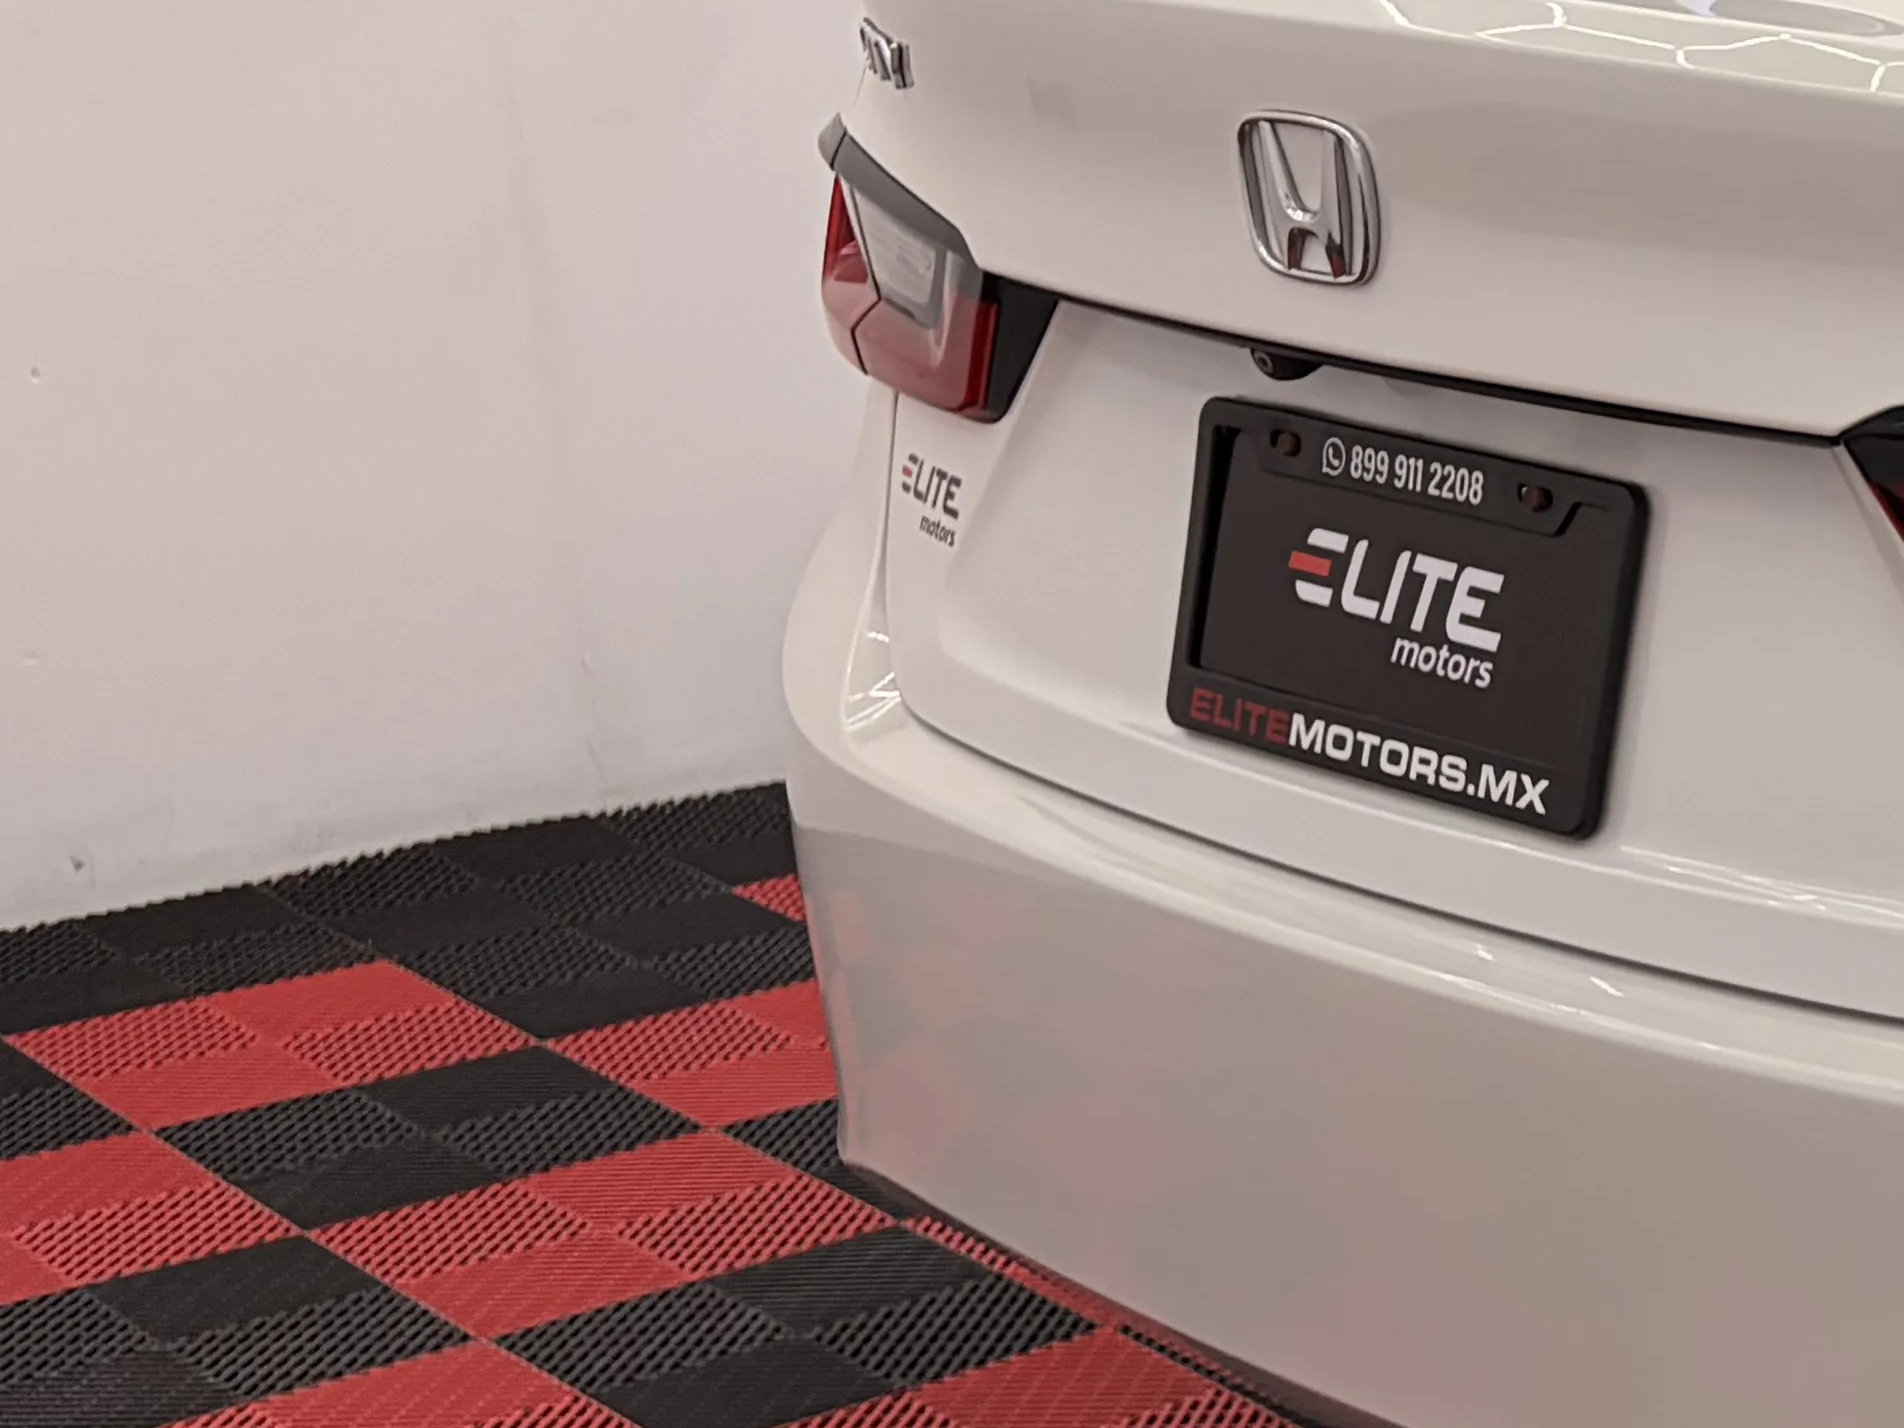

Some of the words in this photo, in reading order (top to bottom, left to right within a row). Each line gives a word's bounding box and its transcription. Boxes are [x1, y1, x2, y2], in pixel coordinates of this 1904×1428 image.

[902, 452, 962, 521] ELITE
[1350, 445, 1389, 484] 899
[1394, 454, 1423, 492] 911
[1427, 462, 1484, 505] 2208
[919, 515, 957, 548] motors
[1288, 527, 1505, 653] ELITE
[1390, 637, 1494, 689] motors
[1189, 686, 1550, 816] ELITEMOTORS.MX
